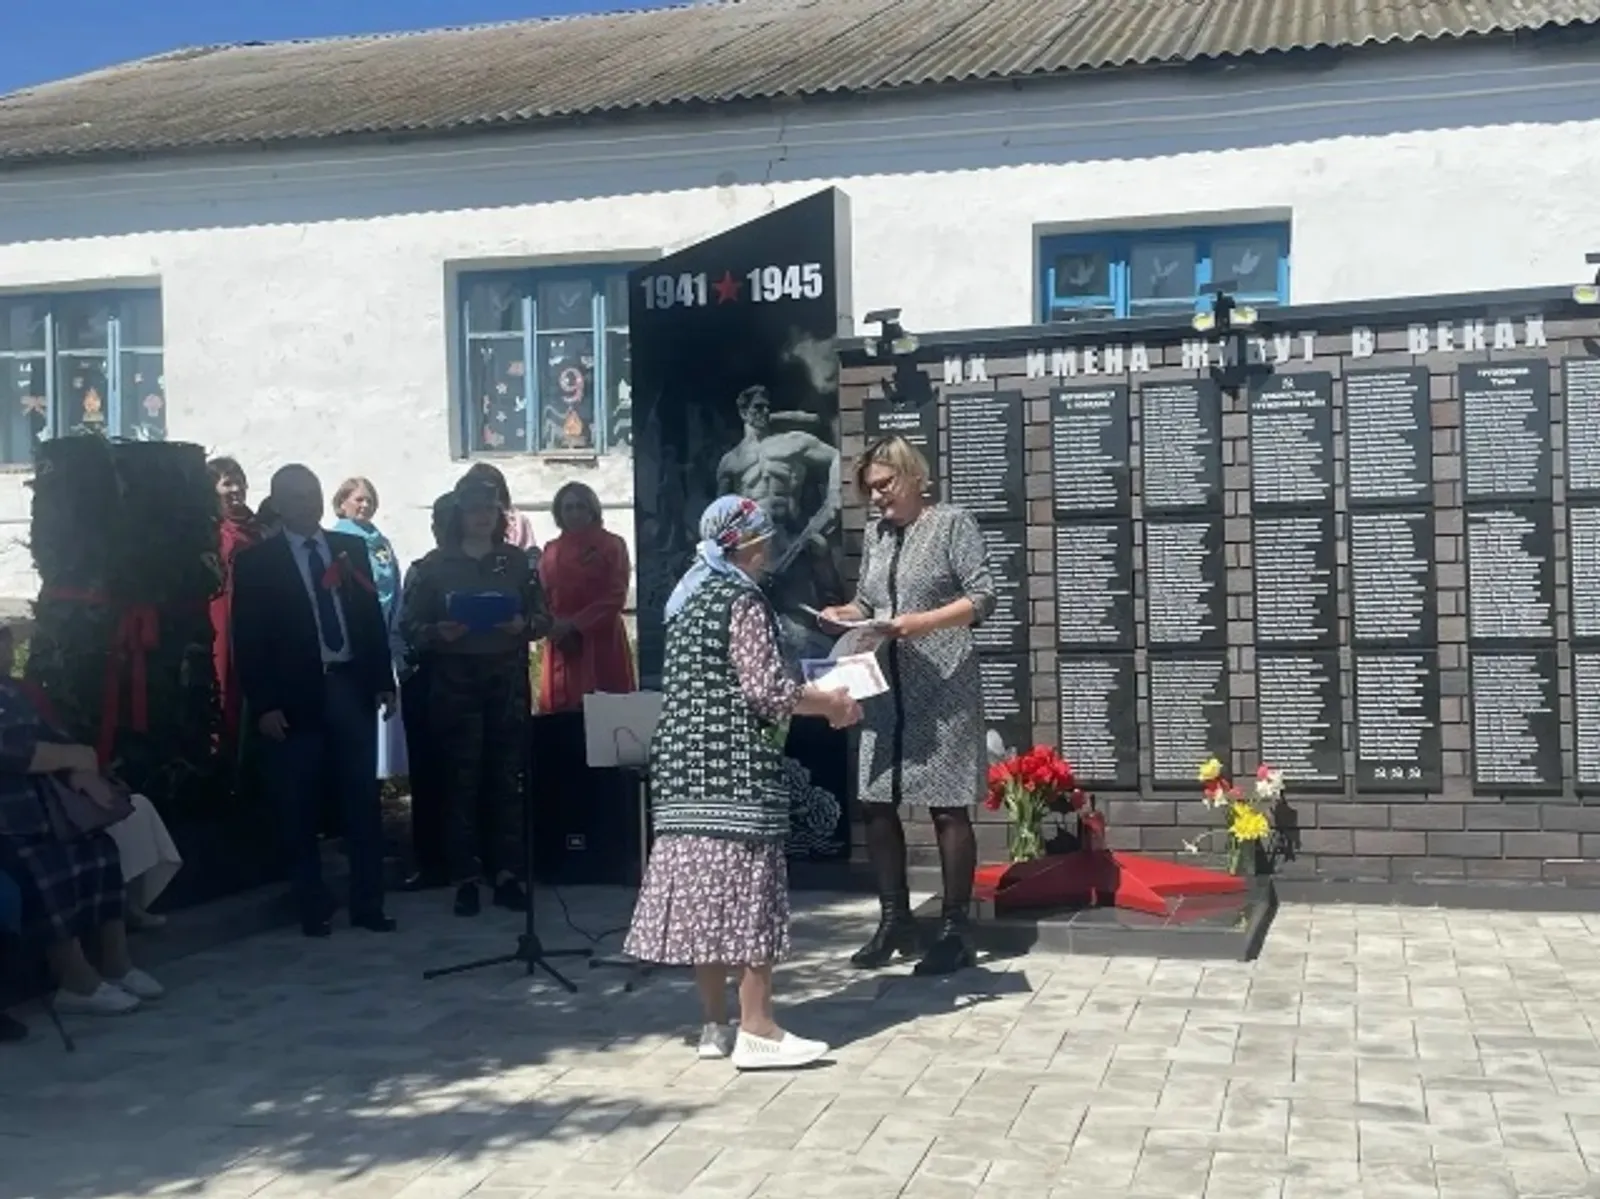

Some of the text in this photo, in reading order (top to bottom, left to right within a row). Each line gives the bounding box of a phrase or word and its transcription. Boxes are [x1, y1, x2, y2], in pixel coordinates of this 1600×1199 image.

[640, 262, 823, 309] 1941 1945
[943, 353, 988, 385] ИХ
[1026, 342, 1150, 379] ИМЕНА
[1352, 325, 1374, 359] В
[1407, 314, 1548, 354] ВЕКАХ
[560, 367, 584, 402] 9
